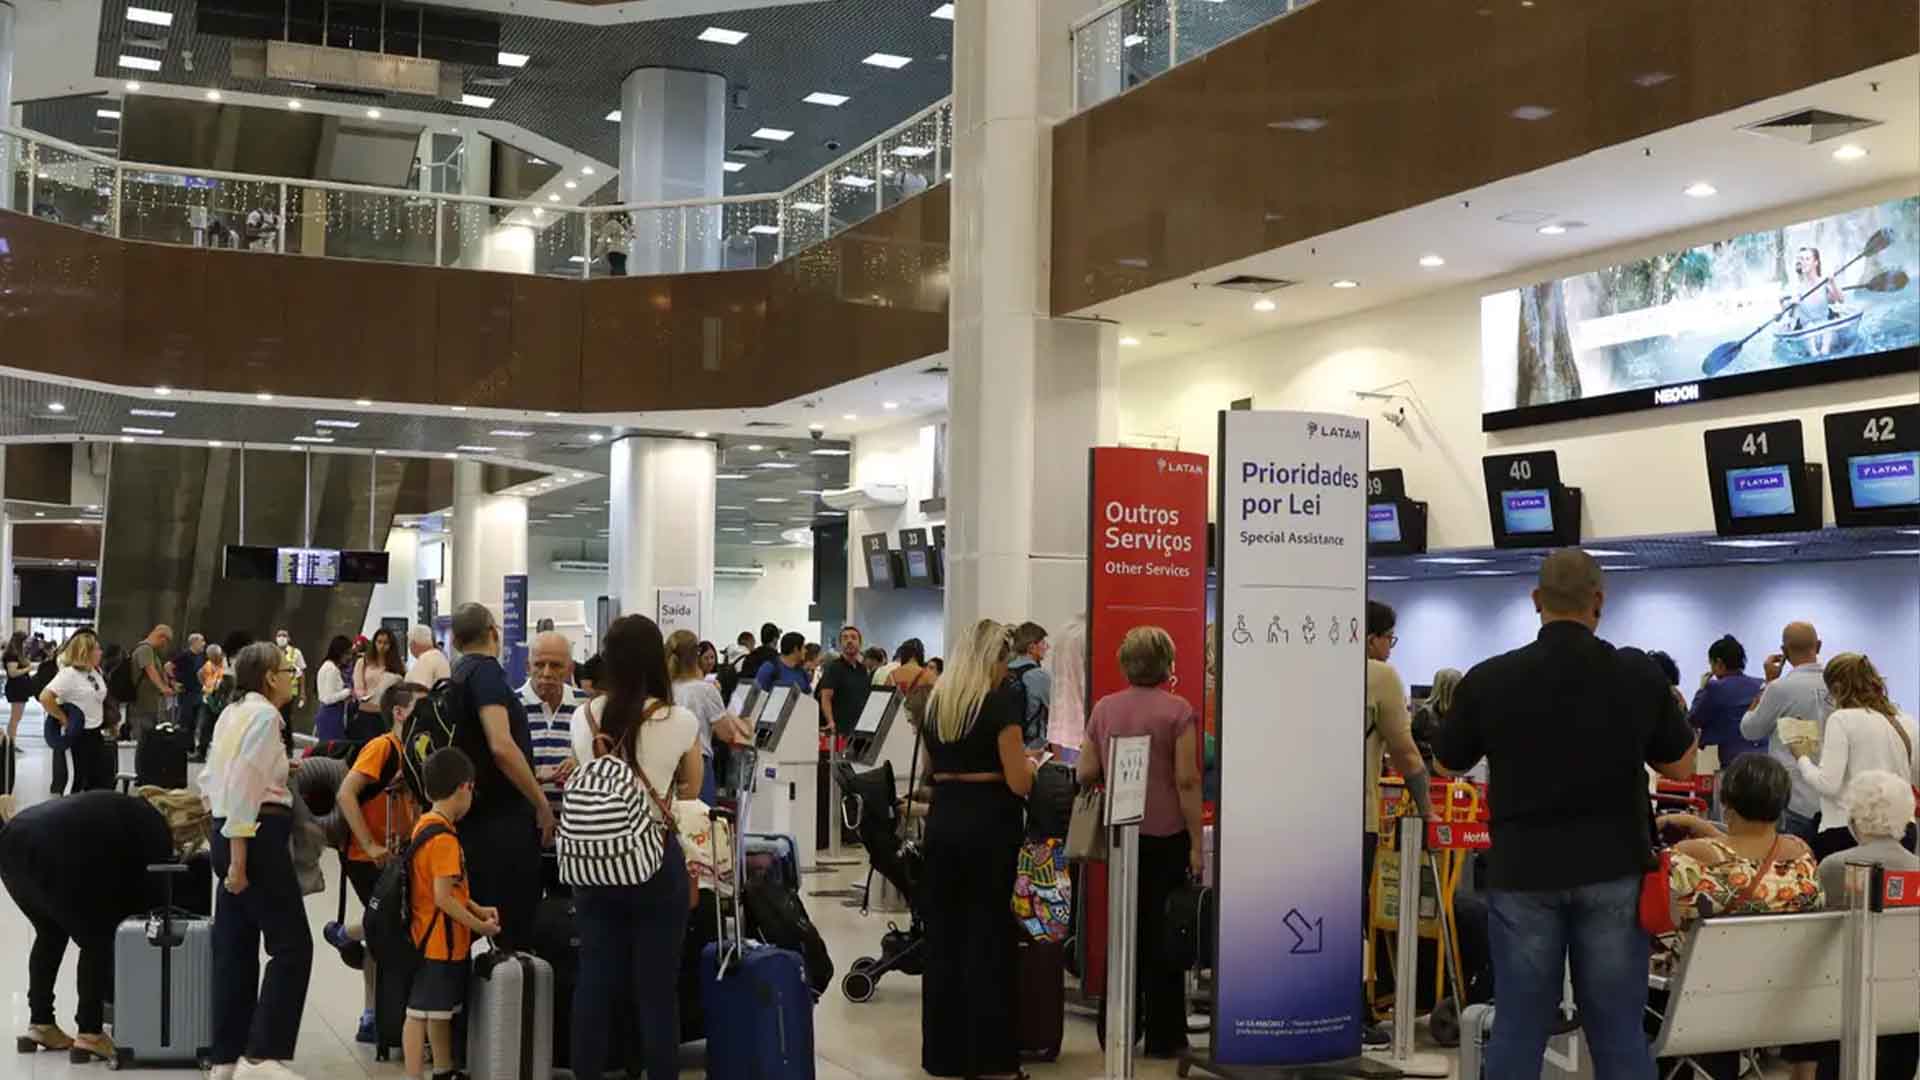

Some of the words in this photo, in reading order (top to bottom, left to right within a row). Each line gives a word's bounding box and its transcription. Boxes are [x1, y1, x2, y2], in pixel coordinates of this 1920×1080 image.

[1321, 425, 1361, 440] LATAM
[1863, 416, 1896, 442] 42
[1742, 431, 1768, 456] 41
[1168, 463, 1203, 475] LATAM
[1242, 461, 1359, 489] Prioridades
[1509, 460, 1532, 480] 40
[1872, 464, 1909, 475] LATAM
[1747, 476, 1779, 488] LATAM
[1105, 501, 1179, 525] Outros
[1242, 498, 1282, 520] por
[1289, 493, 1321, 516] Lei
[1105, 527, 1193, 557] Serviços
[1240, 531, 1285, 546] Special
[1288, 532, 1345, 547] Assistance
[1105, 561, 1143, 576] Other
[1146, 562, 1190, 577] Services
